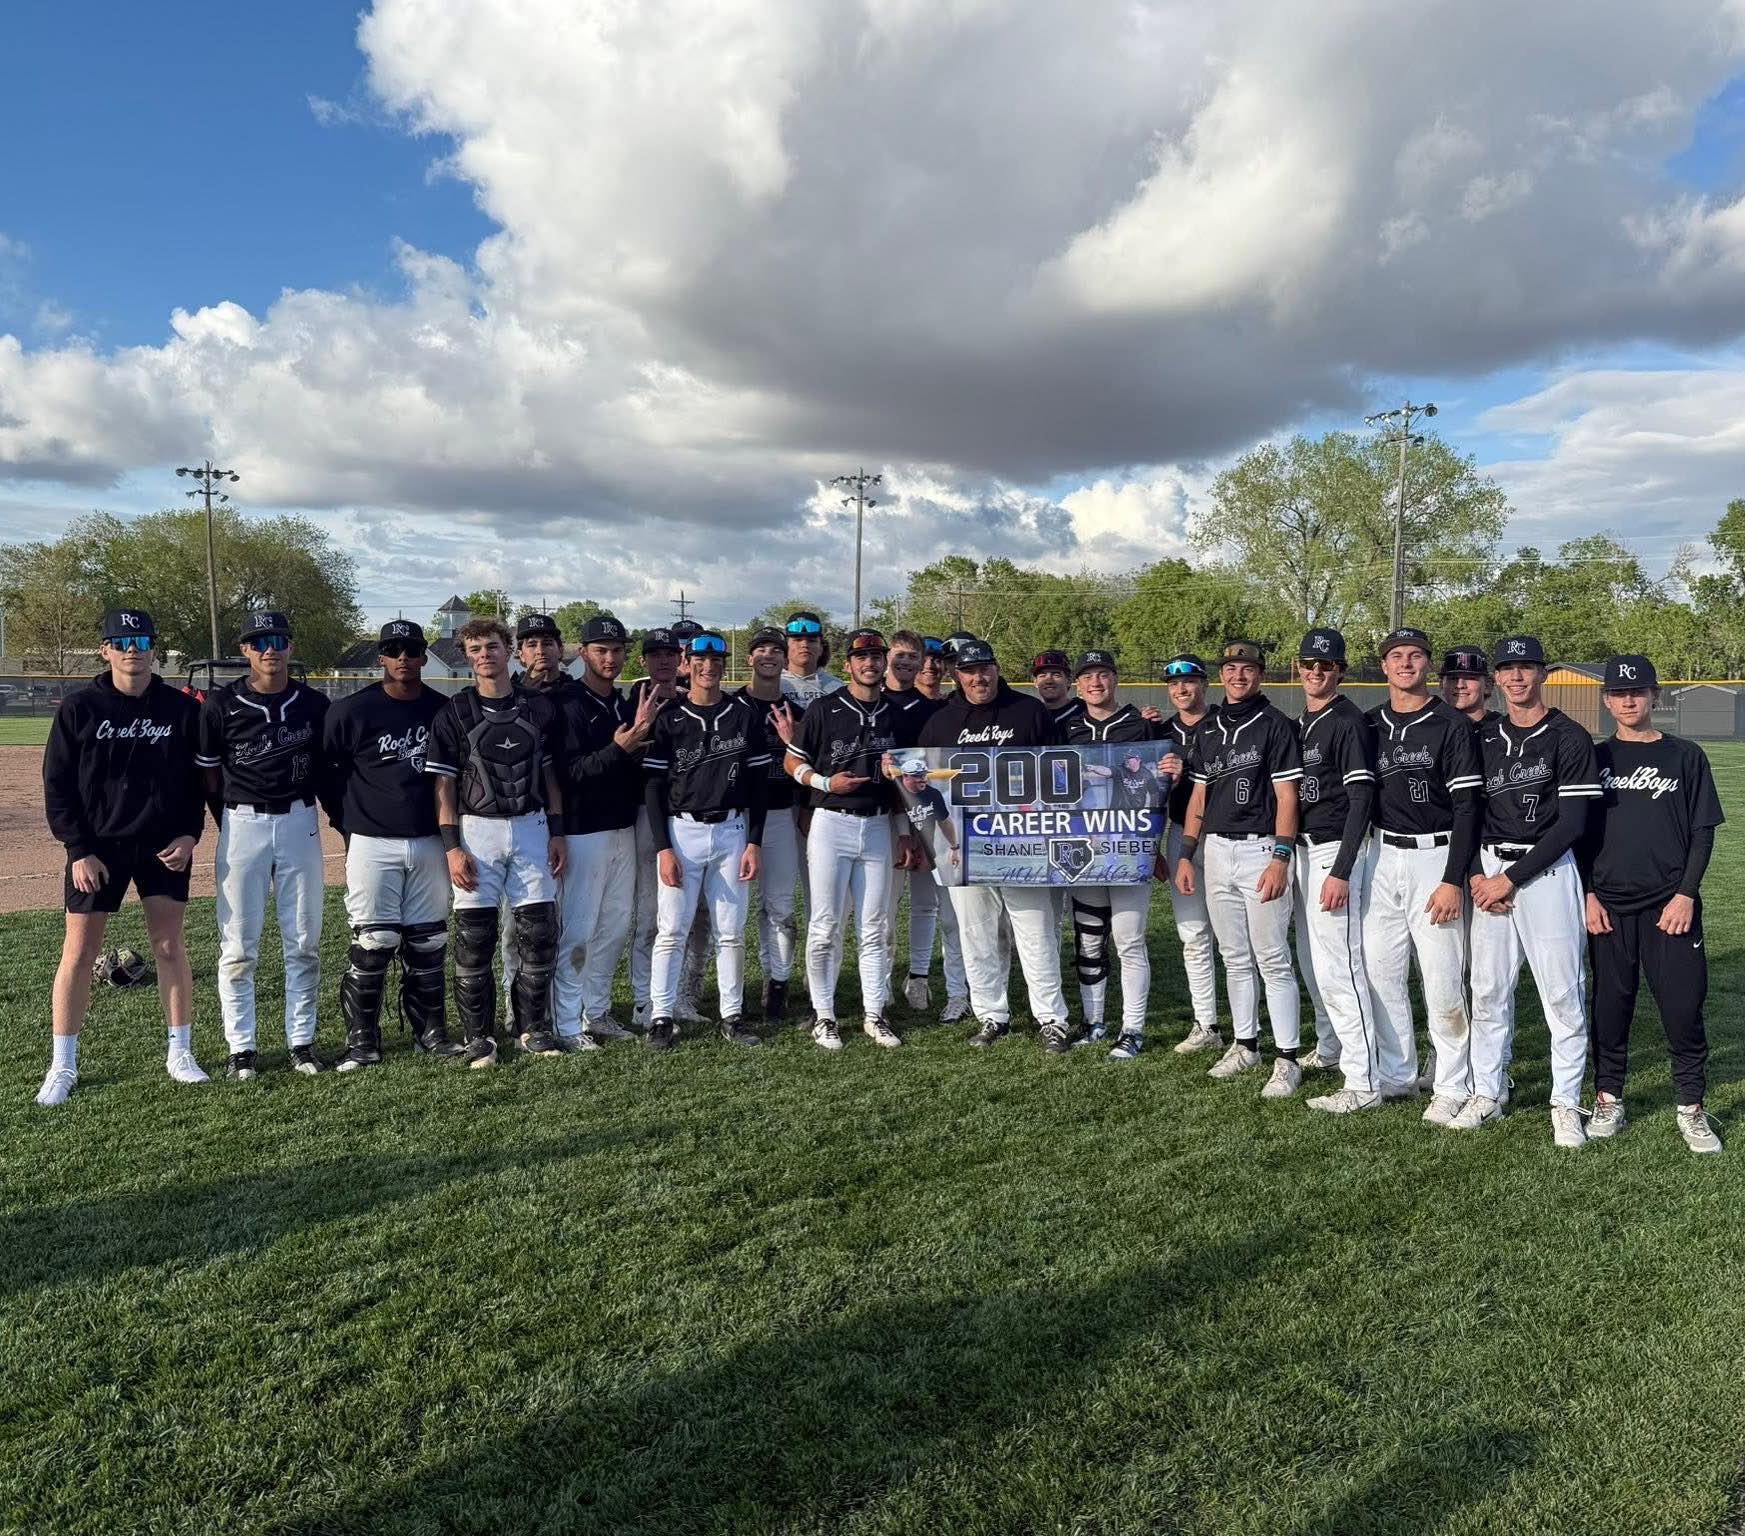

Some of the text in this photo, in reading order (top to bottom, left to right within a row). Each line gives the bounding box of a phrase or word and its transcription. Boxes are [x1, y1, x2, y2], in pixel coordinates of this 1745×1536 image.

[121, 613, 139, 628] RC
[255, 615, 273, 629] RC
[392, 623, 410, 637] RC
[602, 621, 618, 637] RC
[1312, 636, 1330, 652] RC
[1507, 640, 1526, 655] RC
[1618, 664, 1637, 680] RC
[378, 727, 413, 753] Rock
[1393, 745, 1431, 765] Creek
[948, 750, 1082, 807] 200
[1486, 758, 1549, 788] ock Creek
[1235, 778, 1250, 805] 6
[1408, 777, 1430, 803] 21
[1522, 794, 1539, 821] 7
[972, 809, 1152, 836] CAREER WINS
[983, 843, 1044, 856] SHANE
[1057, 843, 1084, 869] RC
